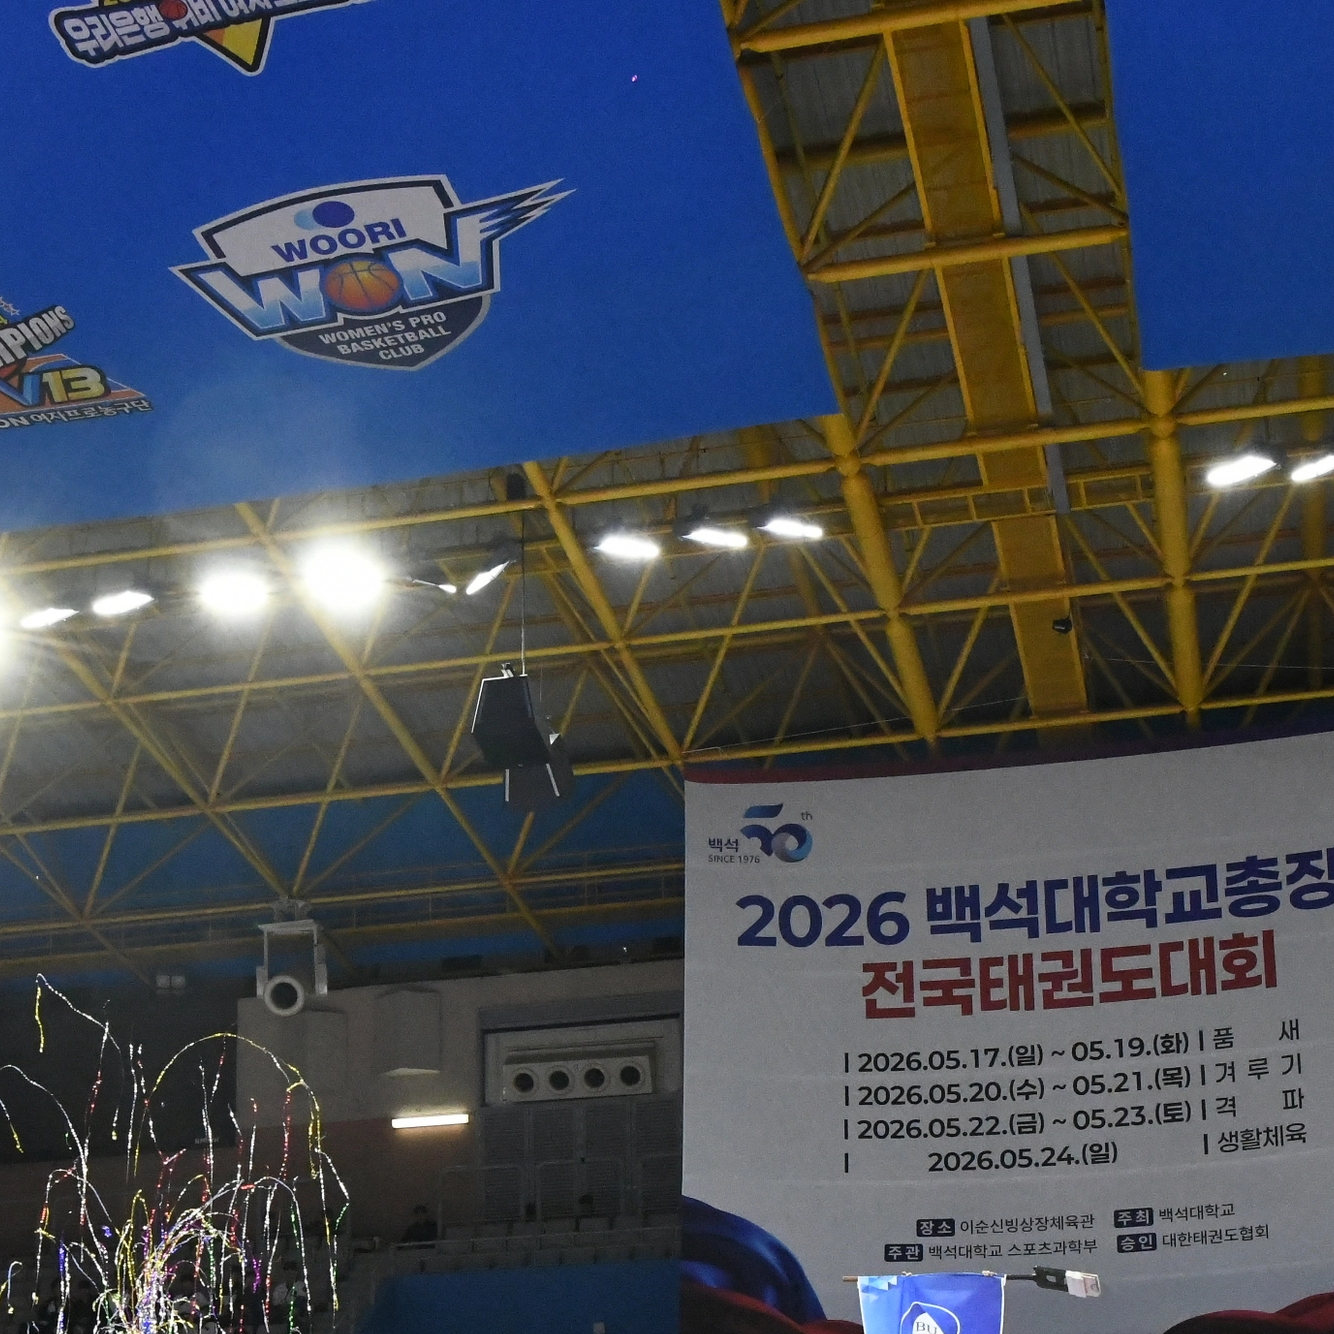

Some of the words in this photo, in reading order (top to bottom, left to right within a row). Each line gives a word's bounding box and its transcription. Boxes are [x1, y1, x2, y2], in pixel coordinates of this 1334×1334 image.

[63, 13, 170, 57] 우리은행
[271, 218, 407, 263] WOORI
[318, 320, 405, 345] WOMEN'S
[409, 311, 447, 328] PRO
[337, 326, 451, 355] BASKETBALL
[378, 344, 425, 361] CLUB
[32, 399, 151, 425] 여자프로농구단
[800, 811, 814, 821] th
[708, 837, 740, 853] 백석
[708, 854, 736, 864] SINCE
[738, 854, 761, 864] 1976
[735, 891, 911, 948] 2026
[861, 929, 1278, 1019] 전국태권도대회
[857, 1044, 1044, 1073] 2026.05.17.(일)
[1071, 1031, 1189, 1062] 05.19.(화)
[857, 1077, 1045, 1106] 2026.05.20.(수)
[1072, 1065, 1191, 1096] 05.21.(목)
[857, 1111, 1045, 1140] 2026.05.22.(금)
[1072, 1100, 1191, 1131] 05.23.(토)
[927, 1142, 1118, 1173] 2026.05.24.(일)
[1217, 1122, 1307, 1153] 생활체육
[960, 1214, 1095, 1235] 이순신빙상장체육관
[1158, 1203, 1236, 1222] 백석대학교
[928, 1243, 1003, 1260] 백석대학교
[1007, 1239, 1098, 1257] 스포츠과학부
[1162, 1224, 1270, 1248] 대한태권도협회
